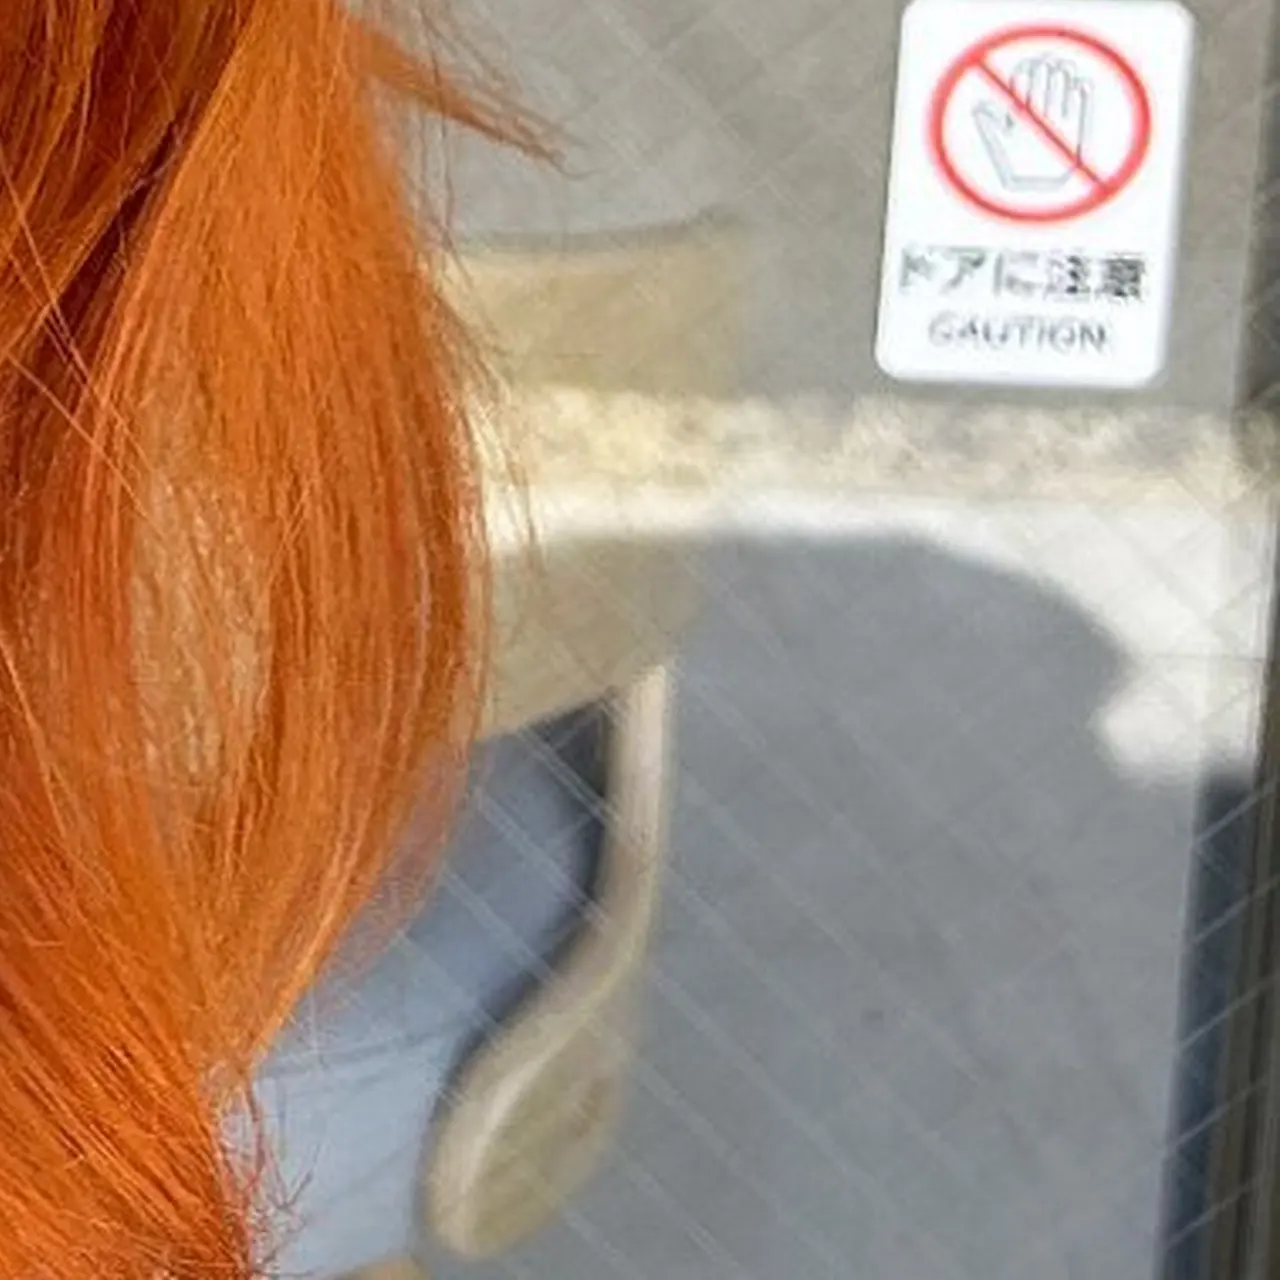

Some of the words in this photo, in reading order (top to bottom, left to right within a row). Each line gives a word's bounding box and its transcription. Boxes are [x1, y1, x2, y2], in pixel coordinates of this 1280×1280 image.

[899, 246, 1146, 302] ドアに注意
[928, 312, 1108, 352] CAUTION
